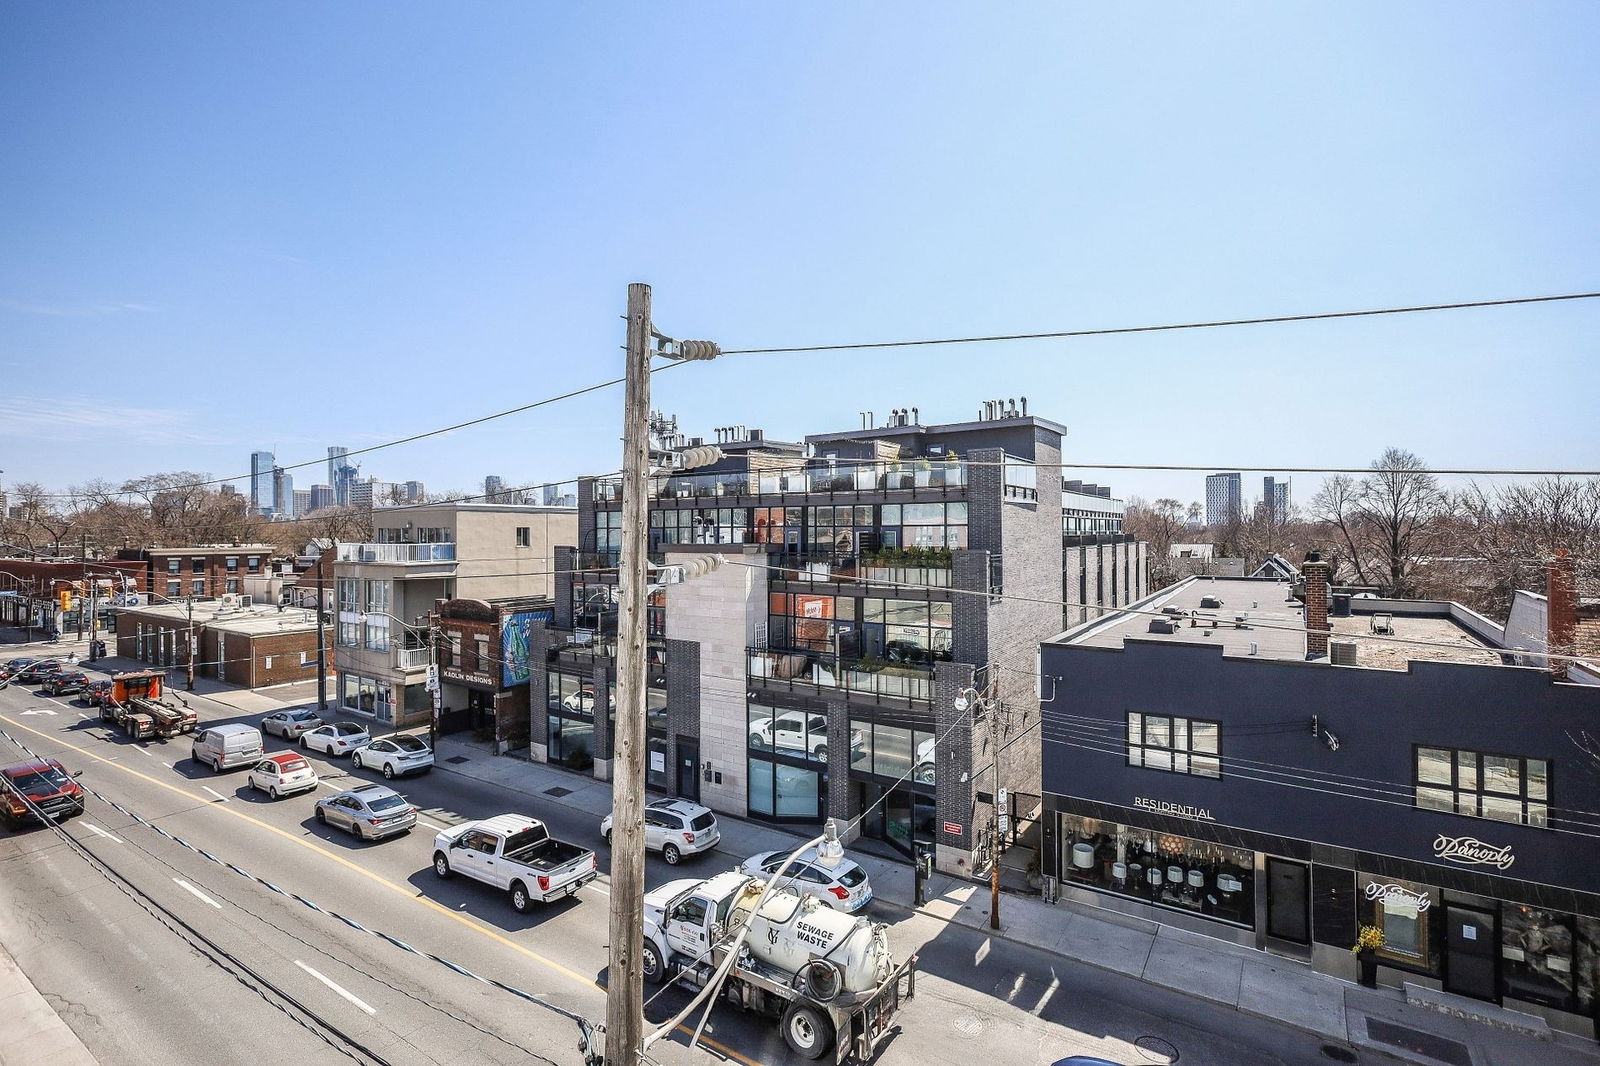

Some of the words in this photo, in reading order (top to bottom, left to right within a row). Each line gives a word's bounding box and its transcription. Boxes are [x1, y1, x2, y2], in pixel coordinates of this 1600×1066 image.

[443, 670, 465, 680] KAOLIN
[465, 674, 493, 685] DESIGNS
[1134, 796, 1214, 820] RESIDENTIAL
[1433, 833, 1515, 870] Panoply
[796, 921, 835, 941] SEWAGE
[797, 930, 828, 949] WASTE
